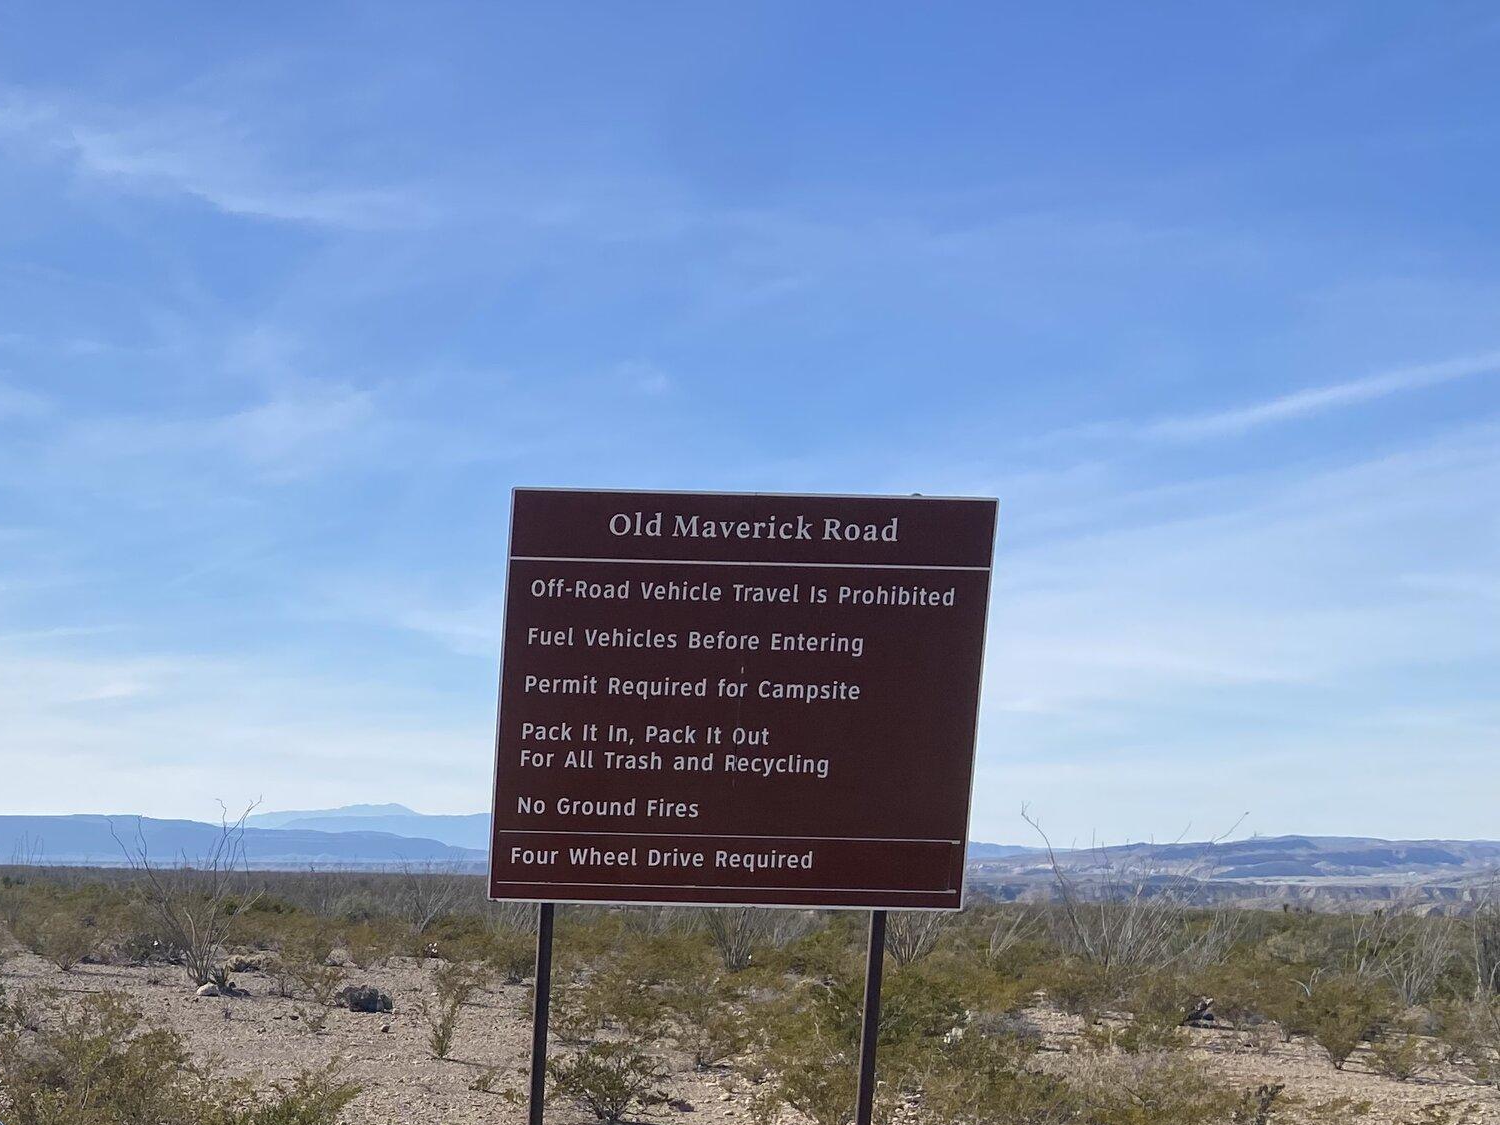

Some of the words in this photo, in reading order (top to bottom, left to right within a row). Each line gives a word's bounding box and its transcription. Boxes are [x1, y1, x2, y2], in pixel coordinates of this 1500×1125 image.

[610, 512, 661, 536] Old
[672, 516, 813, 539] Maverick
[822, 518, 897, 541] Road
[532, 579, 629, 599] Off-Road
[641, 581, 721, 601] Vehicle
[733, 584, 798, 602] Travel
[810, 586, 827, 603] Is
[839, 586, 954, 606] Prohibited
[528, 628, 573, 645] Fuel
[585, 629, 677, 648] Vehicles
[689, 631, 759, 649] Before
[771, 633, 863, 656] Entering
[525, 675, 597, 694] Permit
[609, 677, 706, 700] Required
[718, 679, 747, 697] for
[759, 681, 860, 703] Campsite
[522, 723, 572, 740] Pack
[583, 724, 597, 741] It
[609, 725, 633, 745] In,
[646, 726, 696, 743] Pack
[707, 727, 721, 744] It
[733, 728, 769, 745] Out
[521, 750, 554, 767] For
[564, 750, 593, 768] All
[604, 752, 661, 769] Trash
[674, 753, 713, 771] and
[725, 755, 828, 778] Recycling
[518, 797, 545, 814] No
[557, 798, 635, 816] Ground
[647, 799, 698, 817] Fires
[511, 848, 558, 864] Four
[570, 847, 636, 865] Wheel
[648, 848, 704, 866] Drive
[716, 850, 812, 872] Required
